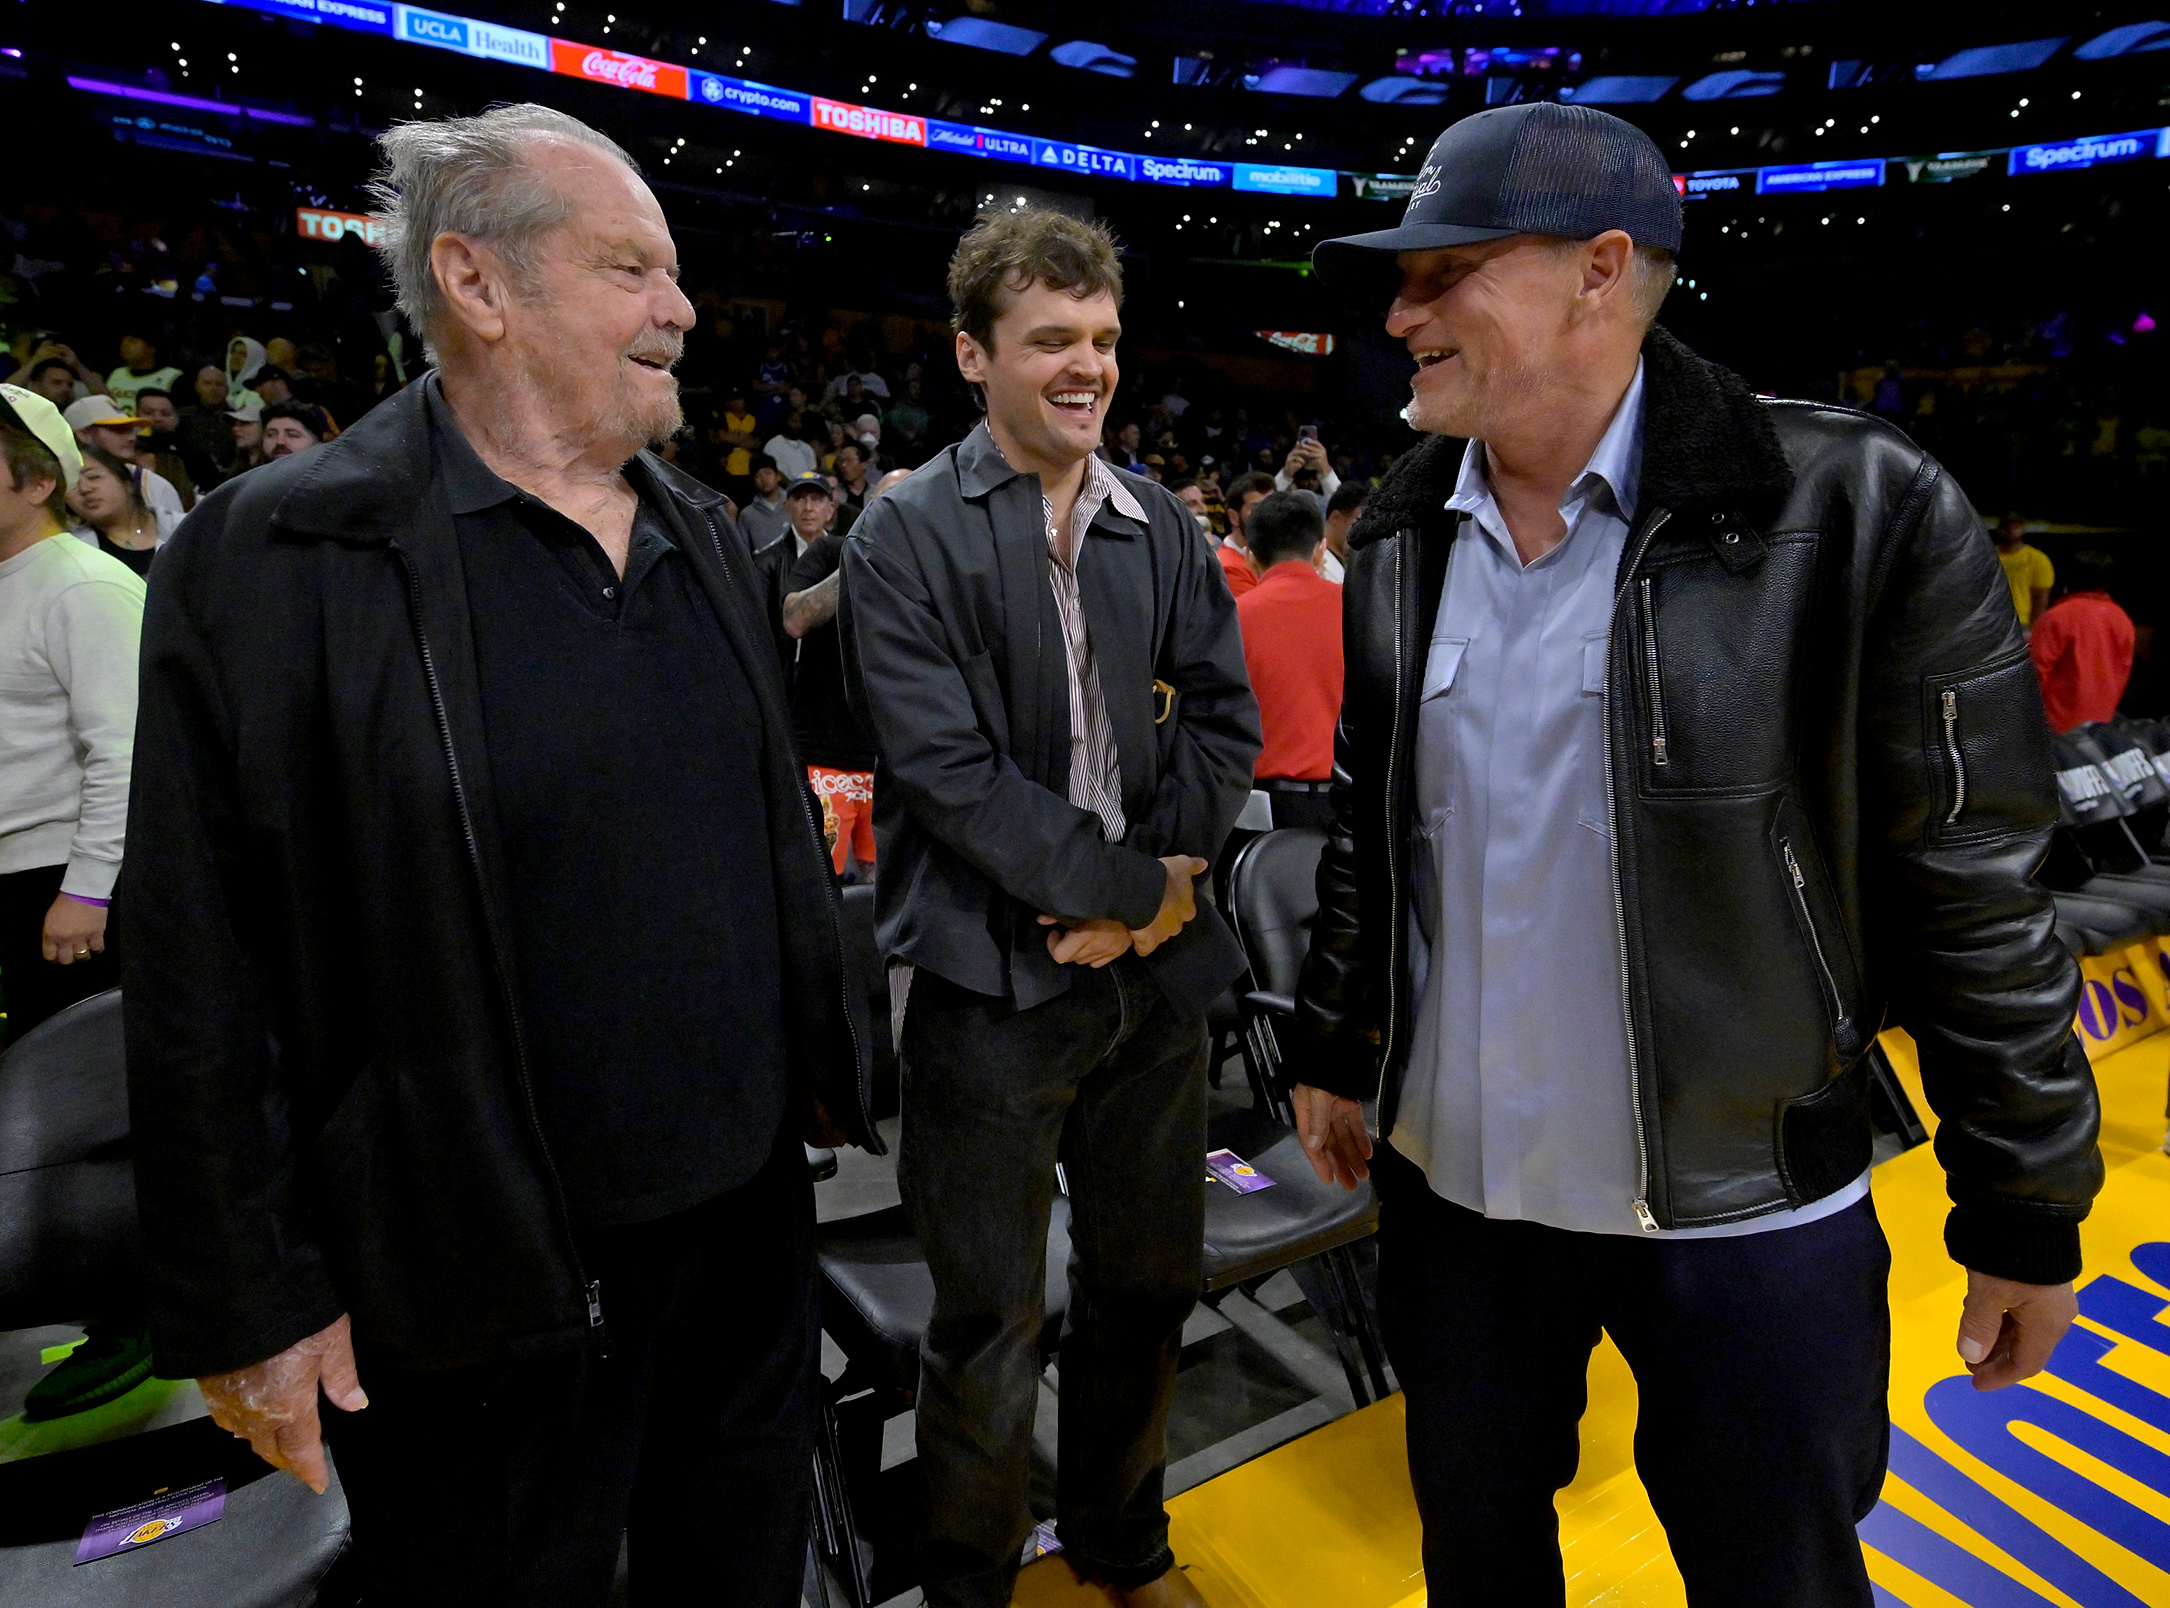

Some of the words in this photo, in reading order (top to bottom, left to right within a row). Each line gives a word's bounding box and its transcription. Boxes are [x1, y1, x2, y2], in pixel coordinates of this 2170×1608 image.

[317, 0, 386, 24] EXPRESS
[414, 18, 462, 43] UCLA
[475, 30, 540, 61] Health
[724, 86, 800, 113] crypto.com
[816, 103, 922, 141] TOSHIBA
[985, 137, 1029, 155] ULTRA
[2025, 138, 2138, 170] Spectrum
[1062, 149, 1126, 173] DELTA
[1142, 158, 1220, 181] Spectrum
[1686, 177, 1739, 192] TOYOTA
[300, 212, 386, 245] TOSH
[2078, 966, 2148, 1048] OS
